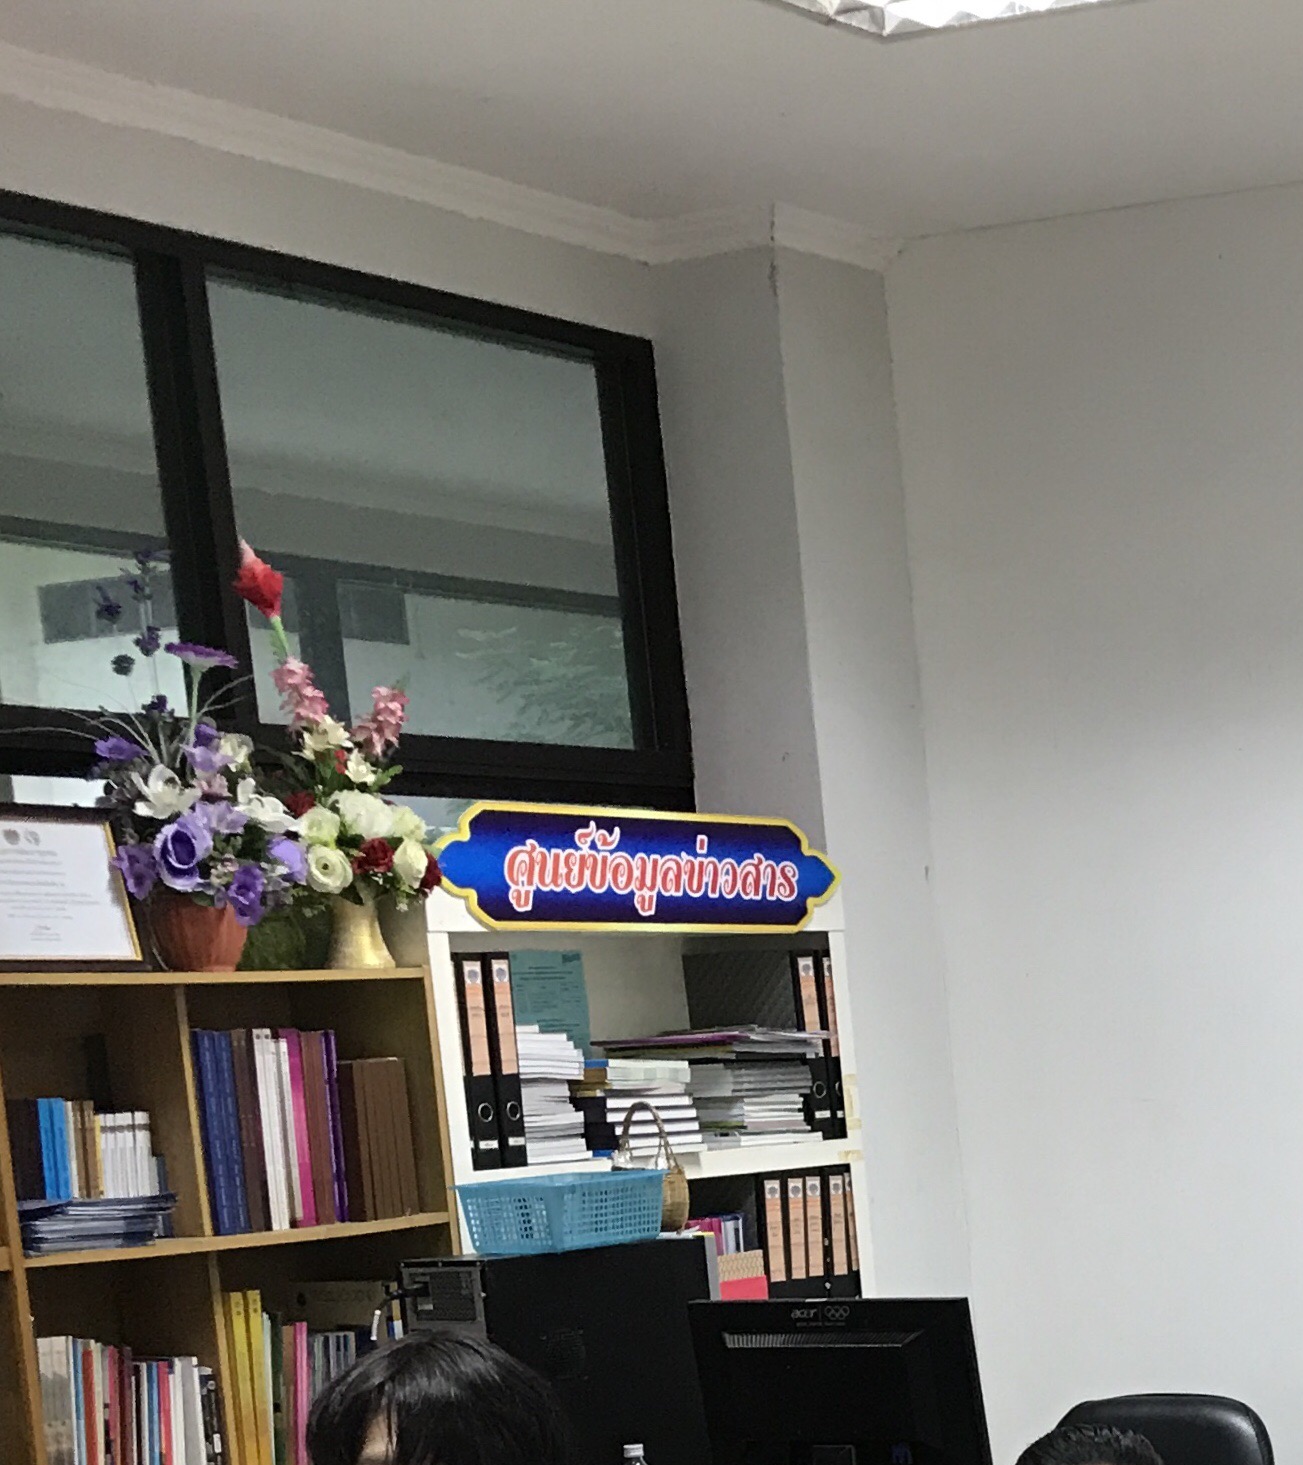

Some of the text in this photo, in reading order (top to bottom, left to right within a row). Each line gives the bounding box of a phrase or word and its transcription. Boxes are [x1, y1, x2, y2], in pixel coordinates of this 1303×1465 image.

[504, 821, 799, 915] ศูนย์ข้อมูลข่าวสาร
[791, 1308, 817, 1320] acer
